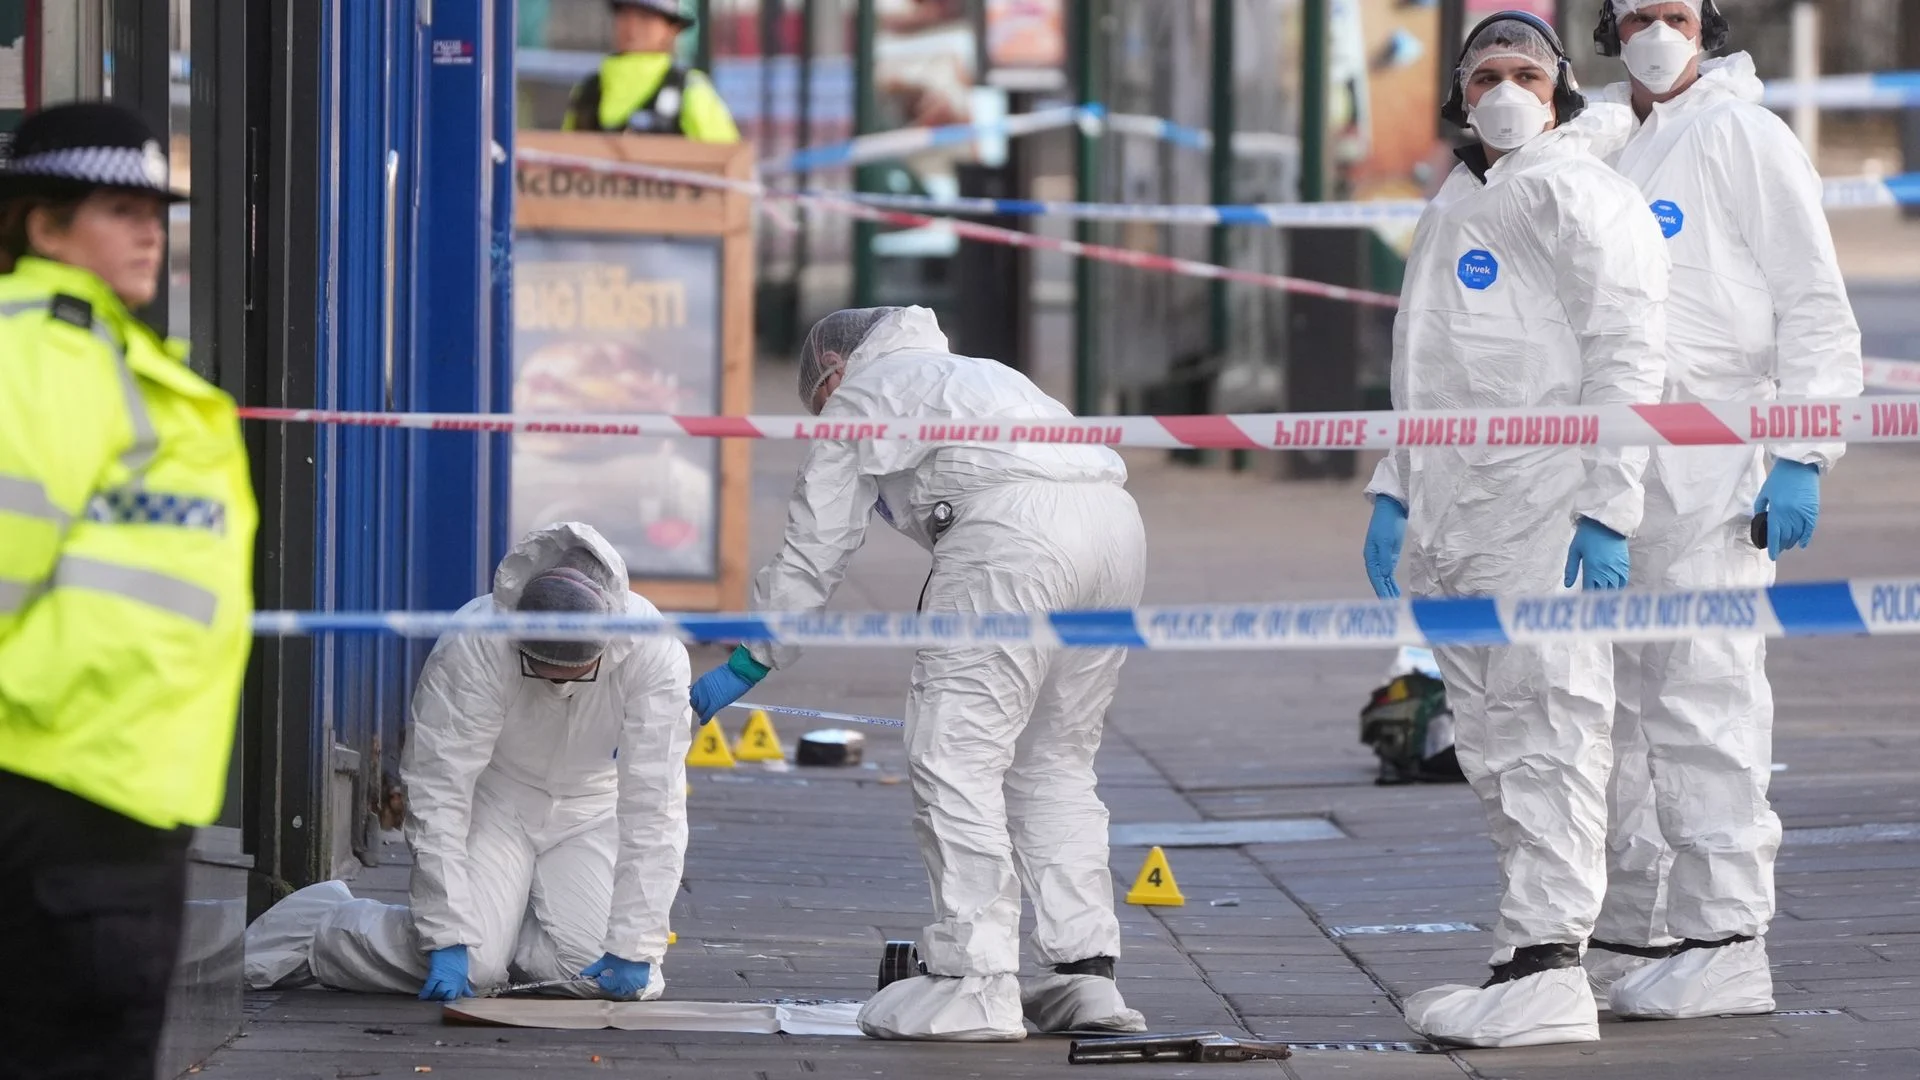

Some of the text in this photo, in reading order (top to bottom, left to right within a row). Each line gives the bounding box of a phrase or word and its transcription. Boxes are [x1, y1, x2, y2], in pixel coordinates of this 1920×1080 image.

[1465, 263, 1490, 275] Tyvek
[1512, 589, 1758, 631] POLICE LINE DO NOT CROSS
[704, 735, 717, 754] 3
[753, 728, 768, 748] 2
[1147, 867, 1162, 887] 4
